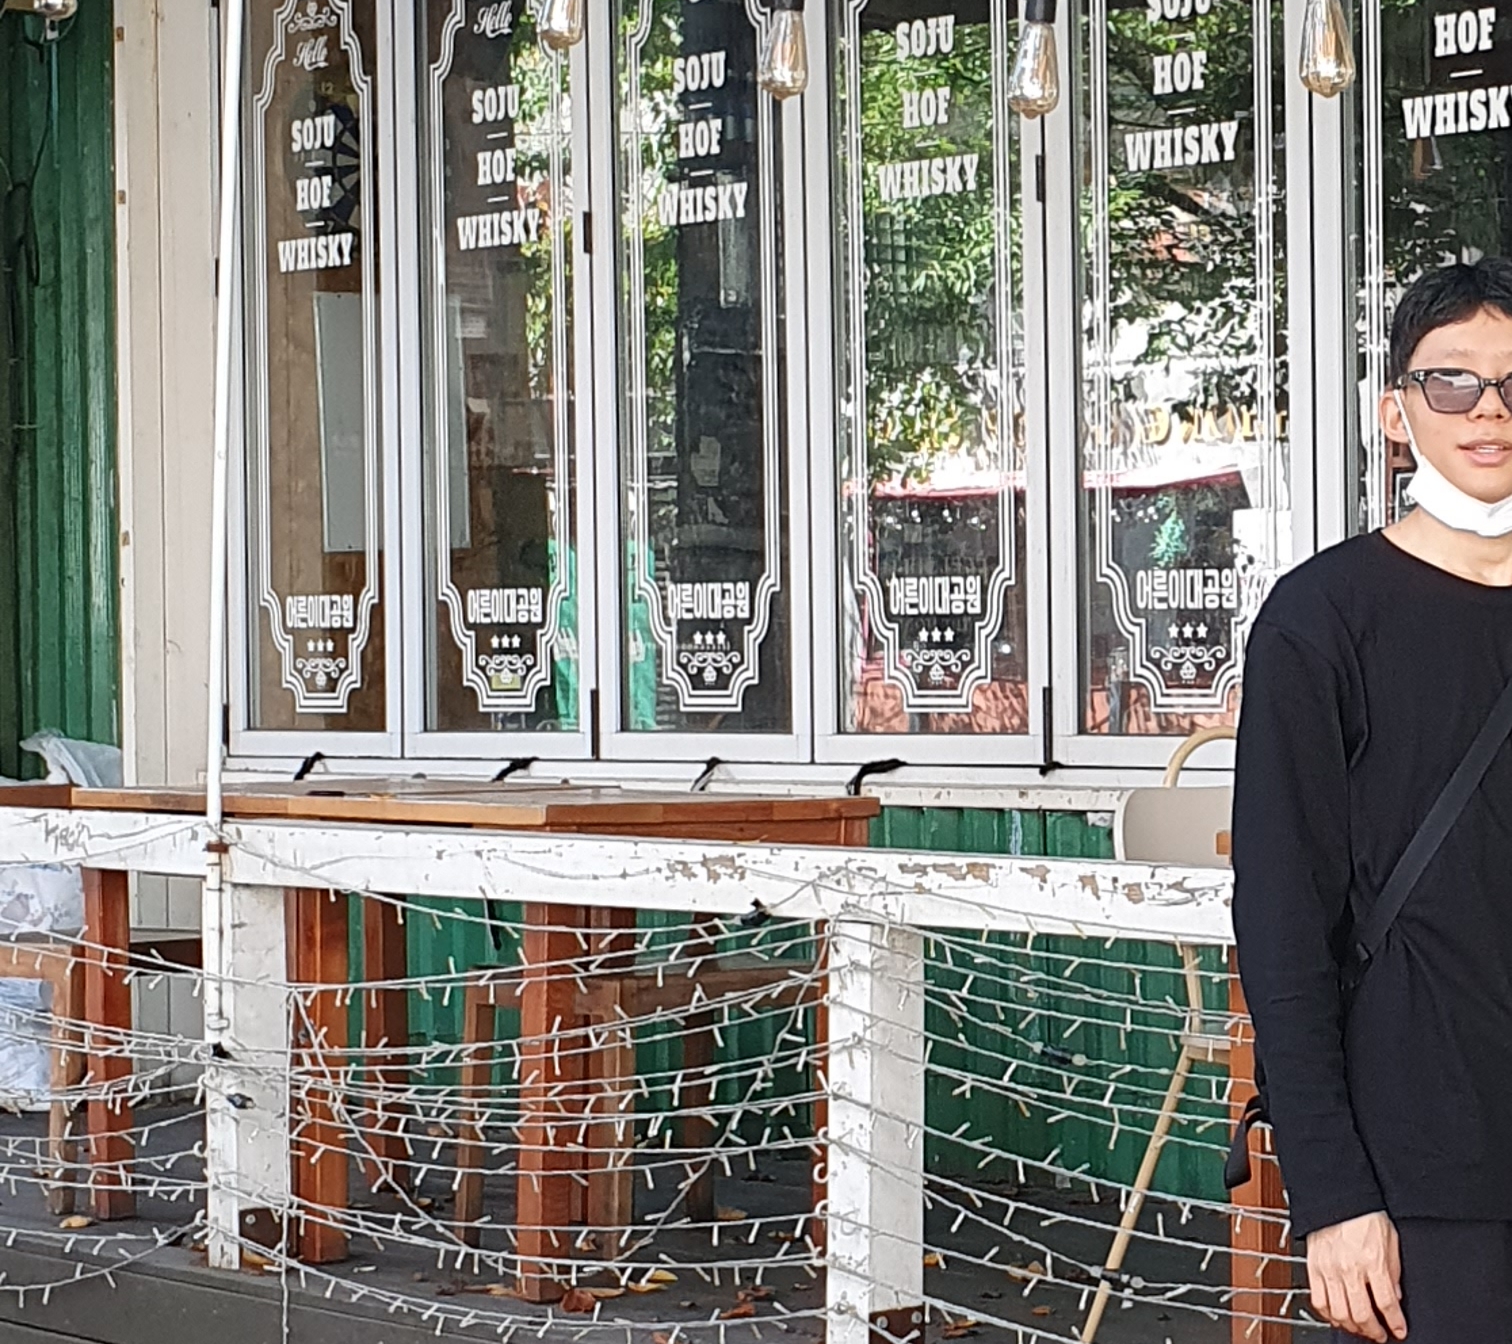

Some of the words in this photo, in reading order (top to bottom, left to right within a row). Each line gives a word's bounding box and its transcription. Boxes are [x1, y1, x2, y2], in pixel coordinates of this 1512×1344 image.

[473, 1, 513, 39] Hello
[896, 14, 955, 57] SOJU
[1434, 8, 1496, 57] HOF
[293, 34, 329, 72] Hello
[673, 51, 725, 93] SOJU
[1152, 52, 1207, 95] HOF
[472, 84, 520, 124] SOJU
[903, 87, 951, 129] HOF
[291, 114, 336, 153] SOJU
[678, 118, 722, 159] HOF
[1124, 120, 1239, 172] WHISKY
[477, 147, 517, 186] HOF
[877, 154, 980, 201] WHISKY
[296, 175, 332, 211] HOF
[658, 182, 749, 226] WHISKY
[457, 208, 541, 252] WHISKY
[278, 233, 354, 273] WHISKY
[466, 587, 543, 625] 어른이대공원
[668, 581, 750, 619] 어른이대공원
[889, 574, 982, 616] 어른이대공원
[1135, 567, 1238, 611] 어른이대공원
[286, 594, 354, 628] 어른이대공원
